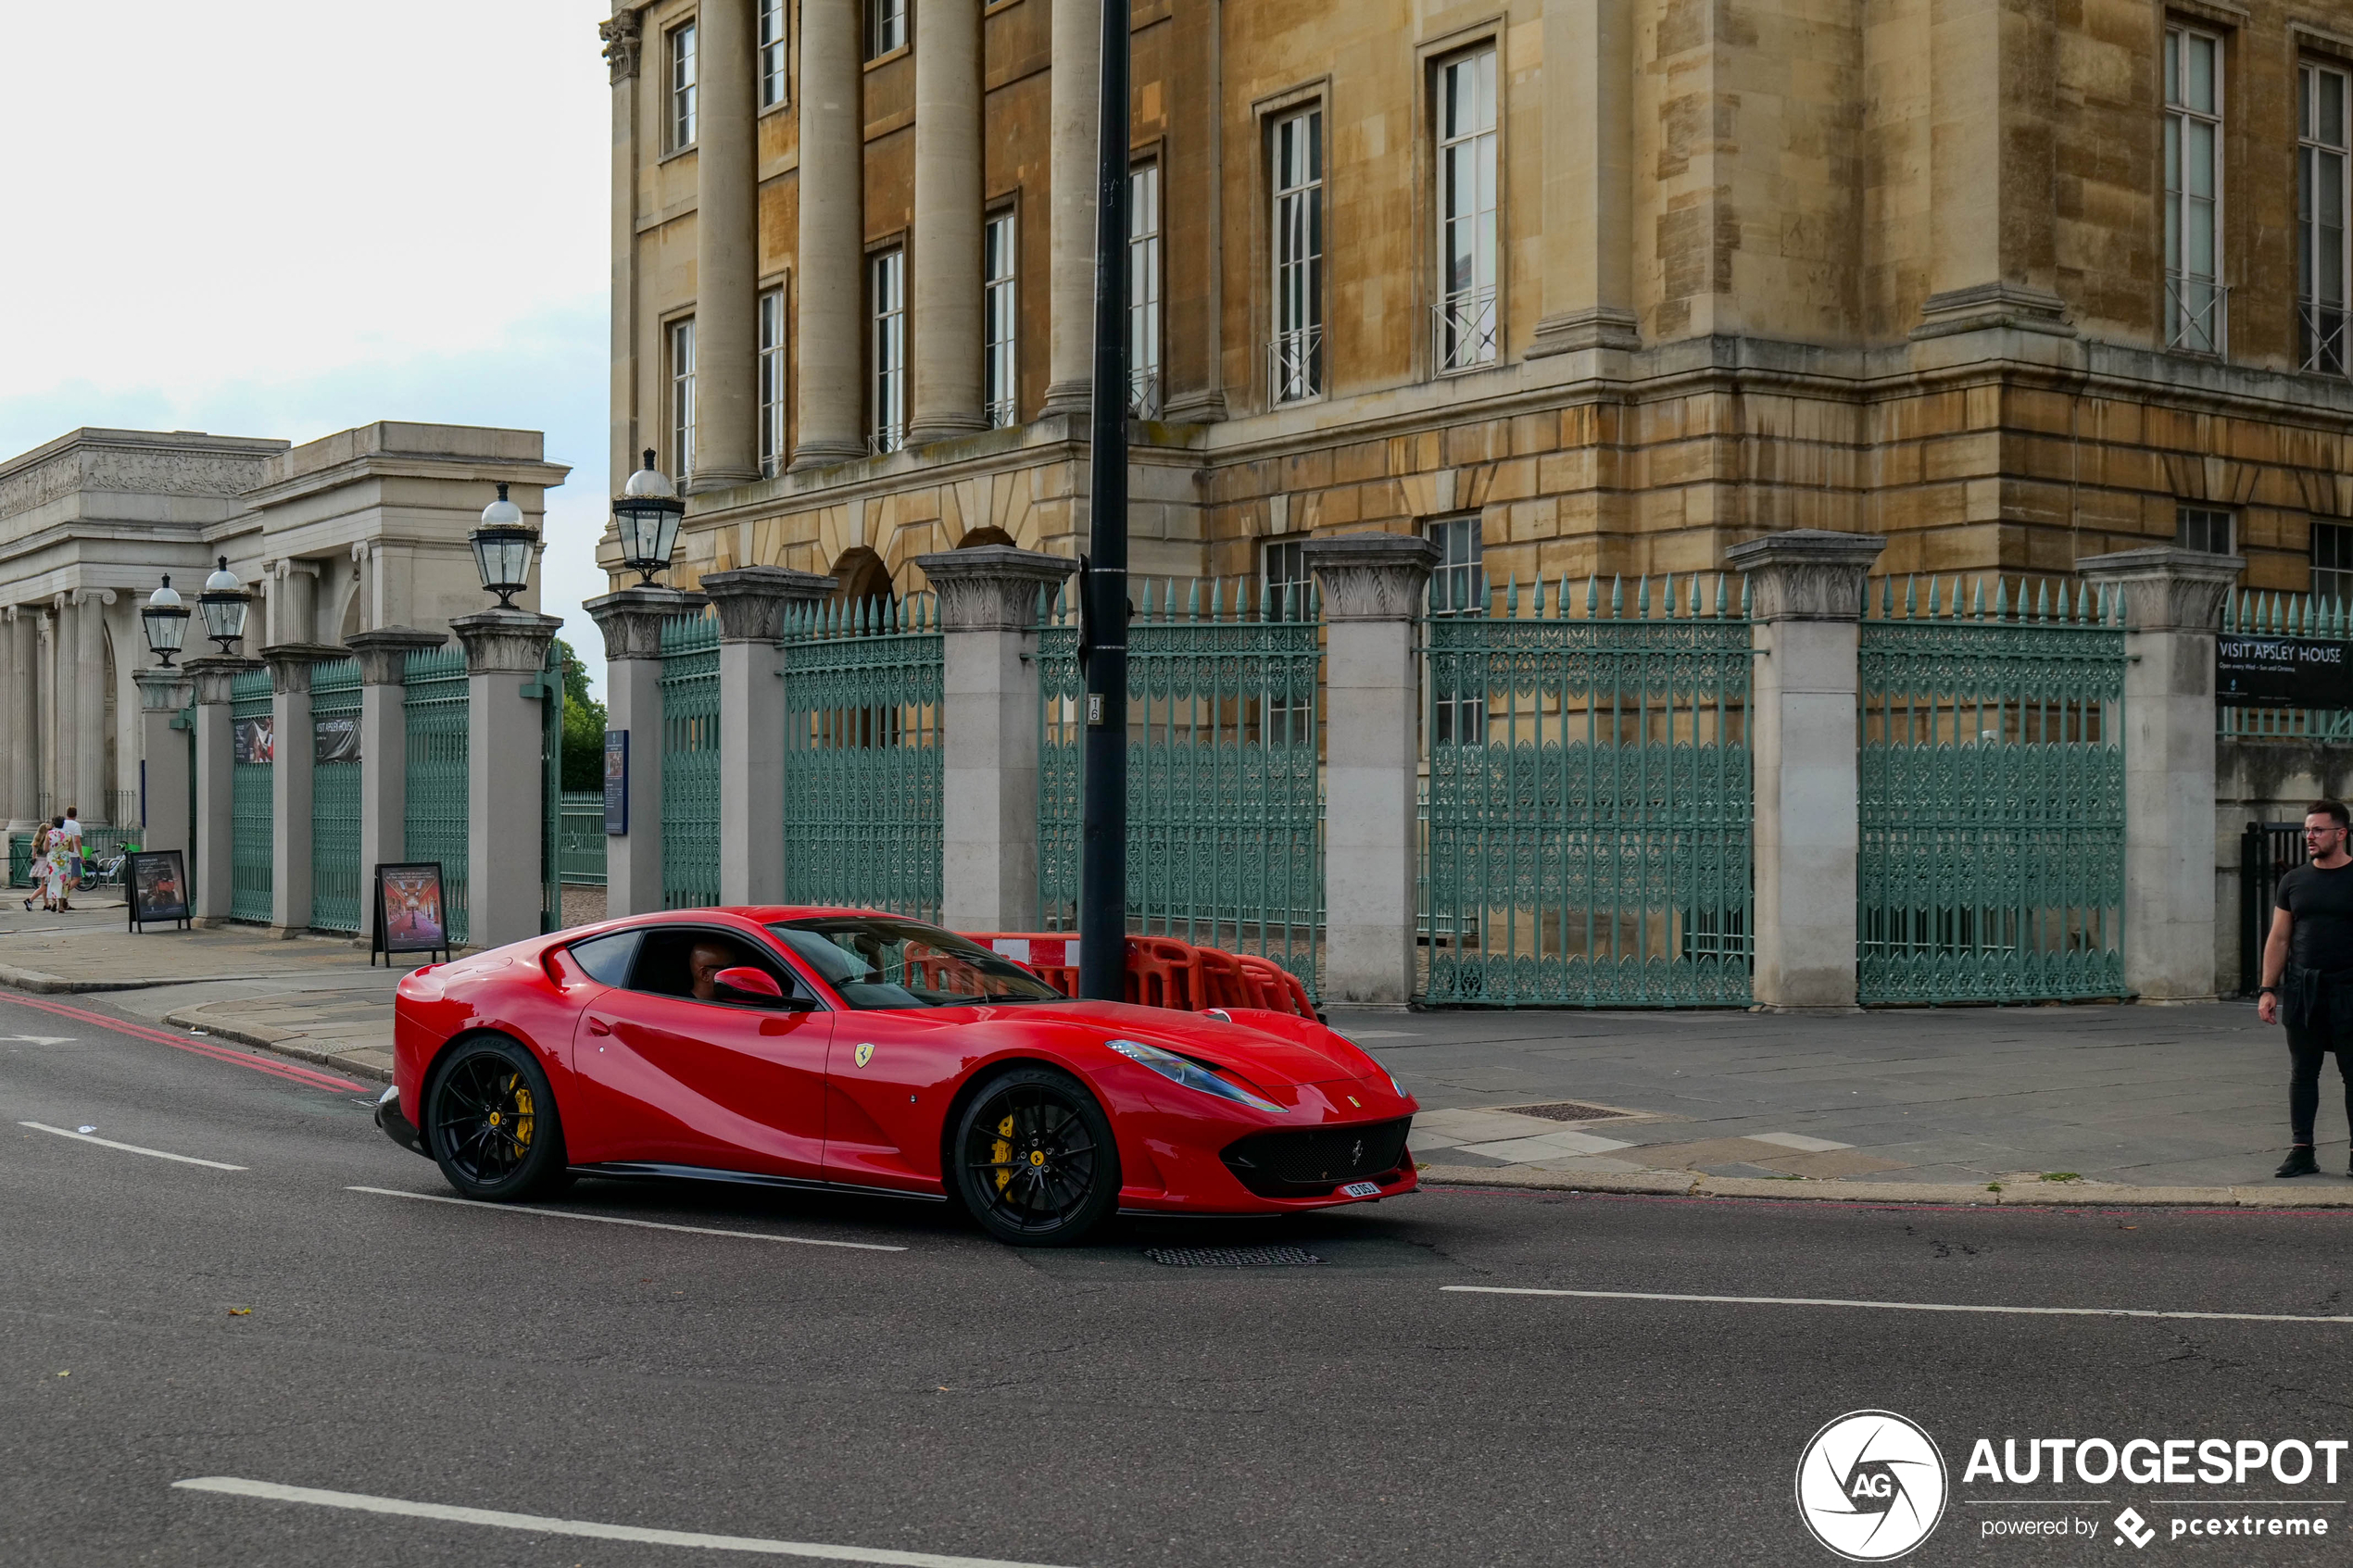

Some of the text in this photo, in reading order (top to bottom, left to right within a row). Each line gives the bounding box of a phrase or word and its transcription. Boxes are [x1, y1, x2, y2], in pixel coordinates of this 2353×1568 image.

[2220, 642, 2341, 663] VISIT APSLEY HOUSE
[2219, 661, 2232, 670] Open
[316, 721, 354, 733] VISIT APSLEY HOUSE
[1349, 1183, 1377, 1196] 13 DSJ
